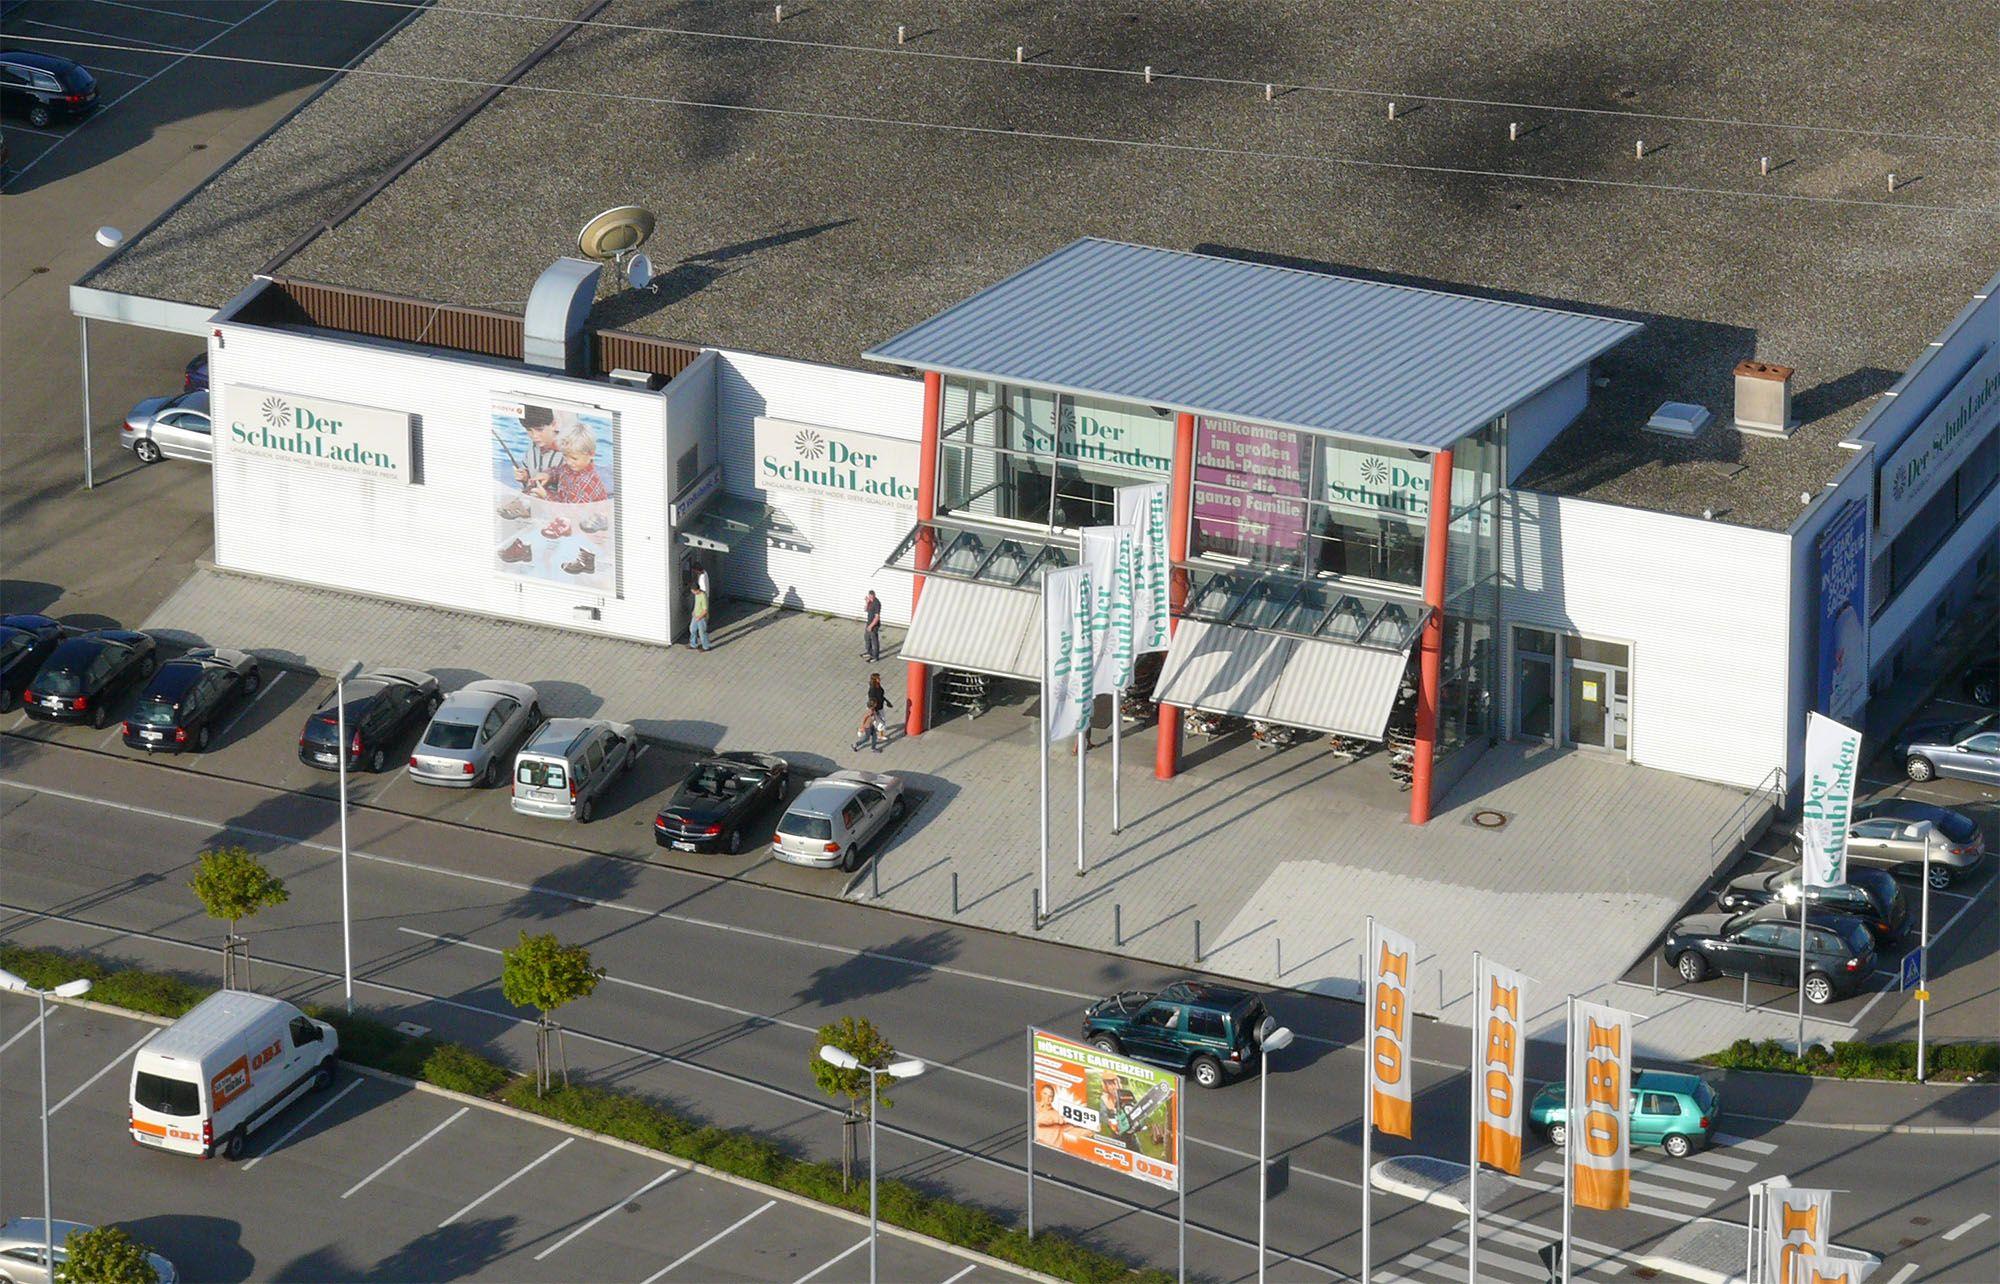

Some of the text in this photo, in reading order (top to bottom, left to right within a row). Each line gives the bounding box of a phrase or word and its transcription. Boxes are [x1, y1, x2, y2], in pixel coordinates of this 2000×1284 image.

[295, 407, 343, 435] Der
[1081, 416, 1124, 441] Der
[829, 440, 878, 469] Der
[1211, 434, 1290, 461] im großen
[1225, 473, 1276, 493] für die
[1907, 449, 1930, 487] Der
[1195, 490, 1300, 517] ganze Familie
[1091, 585, 1112, 631] Der
[1055, 630, 1074, 678] Der
[1803, 774, 1828, 820] Der
[1375, 939, 1409, 1085] OBI
[253, 1039, 283, 1071] OBI
[1486, 974, 1519, 1118] OBI
[1585, 1016, 1622, 1157] OBI
[169, 1128, 200, 1142] OBI
[1136, 1159, 1174, 1182] OBI
